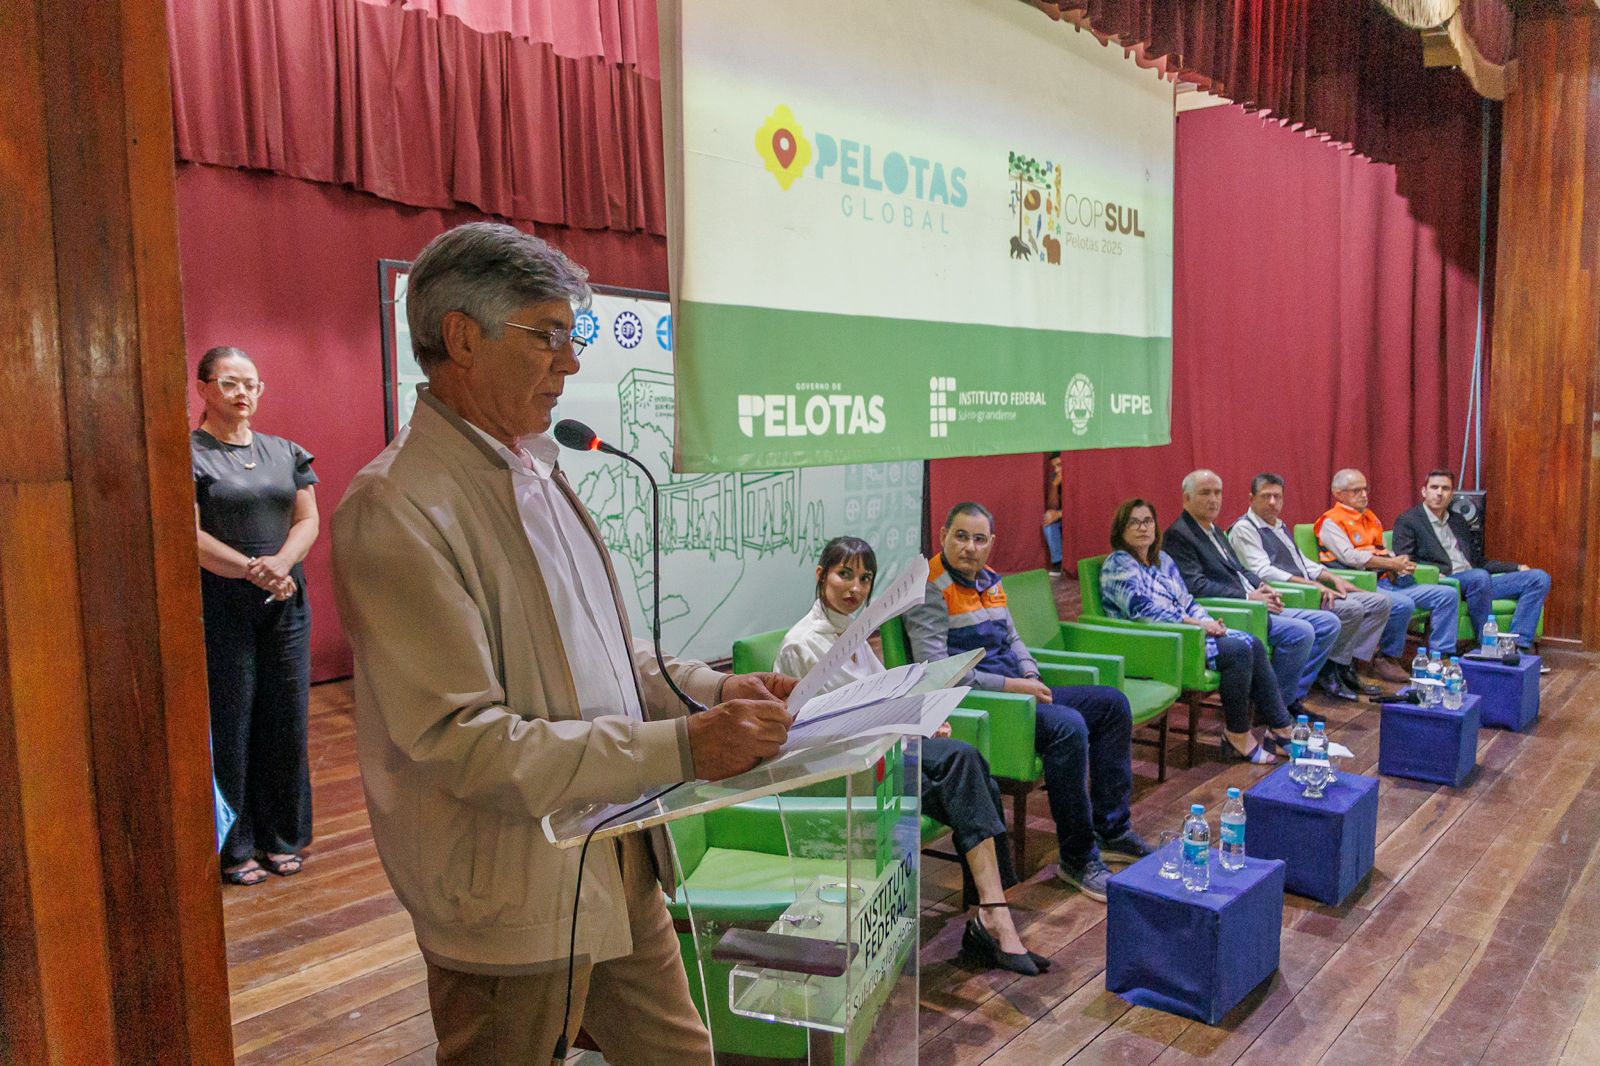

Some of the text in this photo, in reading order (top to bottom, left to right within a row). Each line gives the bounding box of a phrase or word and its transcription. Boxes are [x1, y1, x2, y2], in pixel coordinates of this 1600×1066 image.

[815, 132, 968, 208] PELOTAS
[841, 194, 949, 234] GLOBAL
[1066, 231, 1123, 256] Pelotas 2025
[795, 382, 842, 391] GOVERNO DE
[959, 391, 1047, 406] INSTITUTO FEDERAL
[738, 394, 886, 438] PELOTAS
[859, 851, 913, 946] INSTITUTO
[865, 887, 908, 969] FEDERAL
